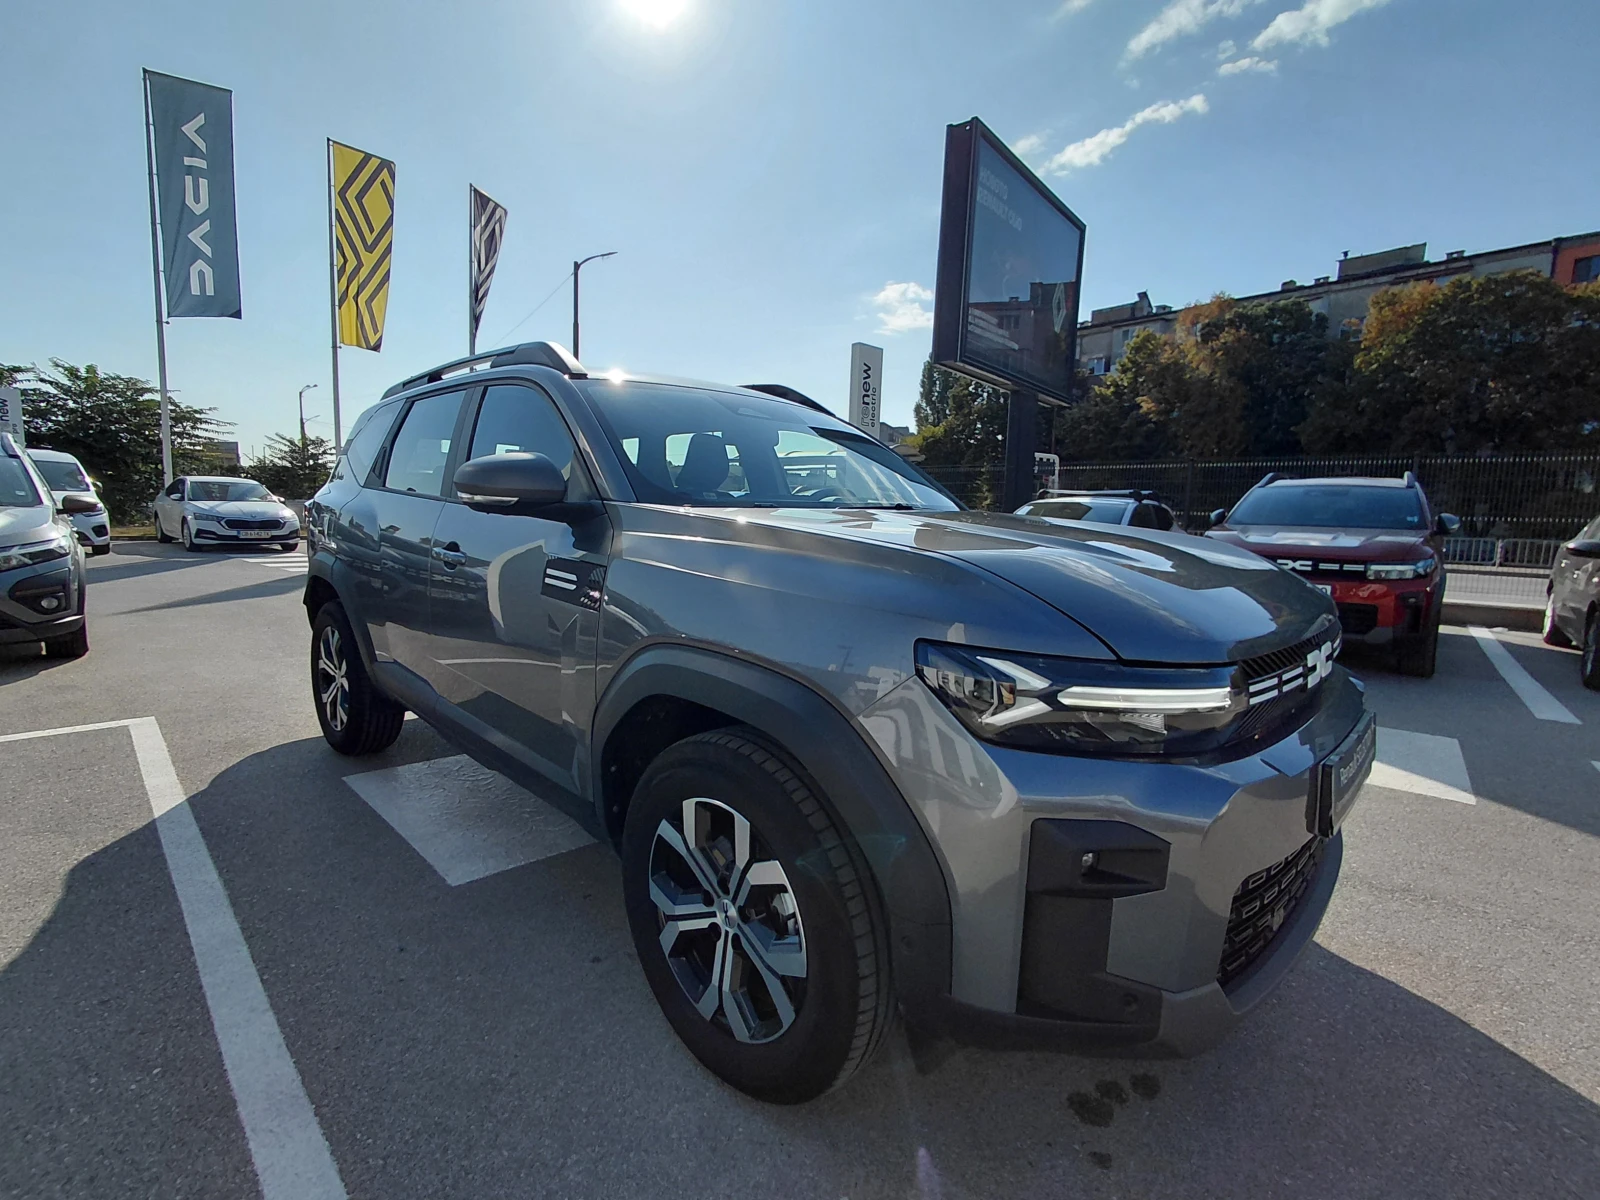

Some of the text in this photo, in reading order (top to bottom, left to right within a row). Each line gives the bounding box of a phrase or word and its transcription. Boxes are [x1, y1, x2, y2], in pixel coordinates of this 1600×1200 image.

[180, 112, 215, 296] DACIA
[861, 362, 872, 427] renew
[869, 386, 877, 428] electric
